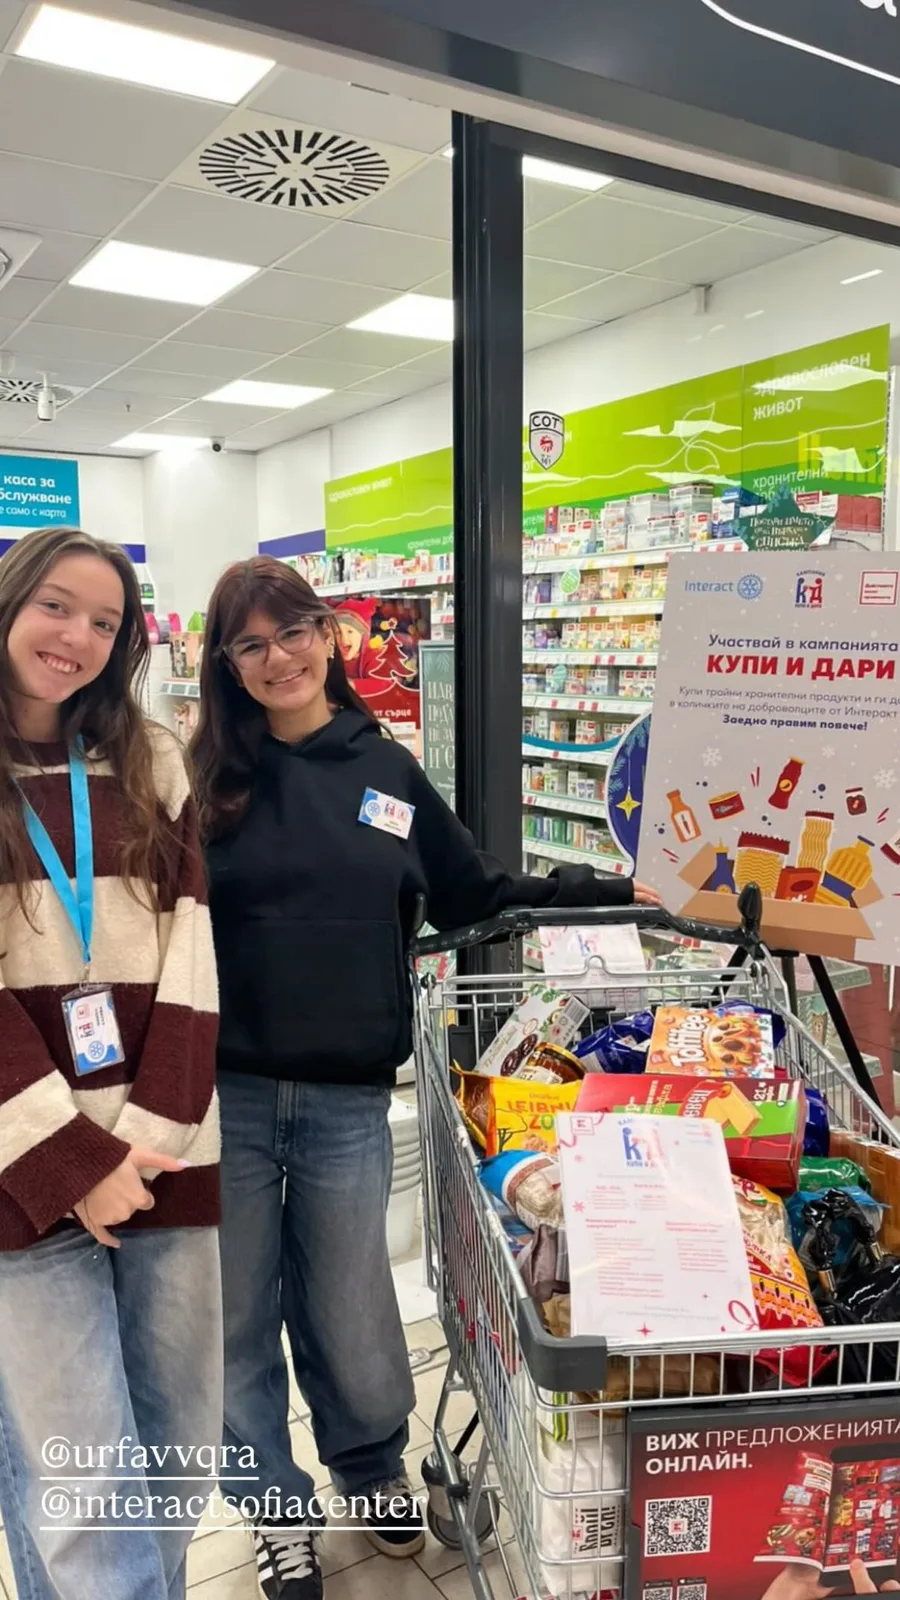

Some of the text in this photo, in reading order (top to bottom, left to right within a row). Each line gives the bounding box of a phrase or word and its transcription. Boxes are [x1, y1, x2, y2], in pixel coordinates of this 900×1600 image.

[3, 475, 56, 488] каса за
[752, 468, 830, 490] хранителни
[6, 506, 31, 516] само
[32, 508, 38, 516] с
[39, 509, 67, 520] карта
[684, 580, 734, 592] Interact
[708, 634, 898, 652] Участвай в кампанията
[706, 654, 895, 681] КУПИ И ДАРИ
[679, 686, 703, 697] Купи
[745, 690, 807, 700] хранителни
[809, 692, 861, 703] продукти
[385, 709, 412, 719] сърце
[669, 700, 898, 718] в количките на доброволците от Интеракт
[722, 714, 868, 731] Заедно правим повече!
[667, 1014, 711, 1067] Toffifee
[507, 1100, 571, 1113] LEIBNI
[529, 1114, 555, 1130] ZO
[646, 1432, 699, 1451] ВИЖ
[646, 1450, 752, 1475] ОНЛАЙН.
